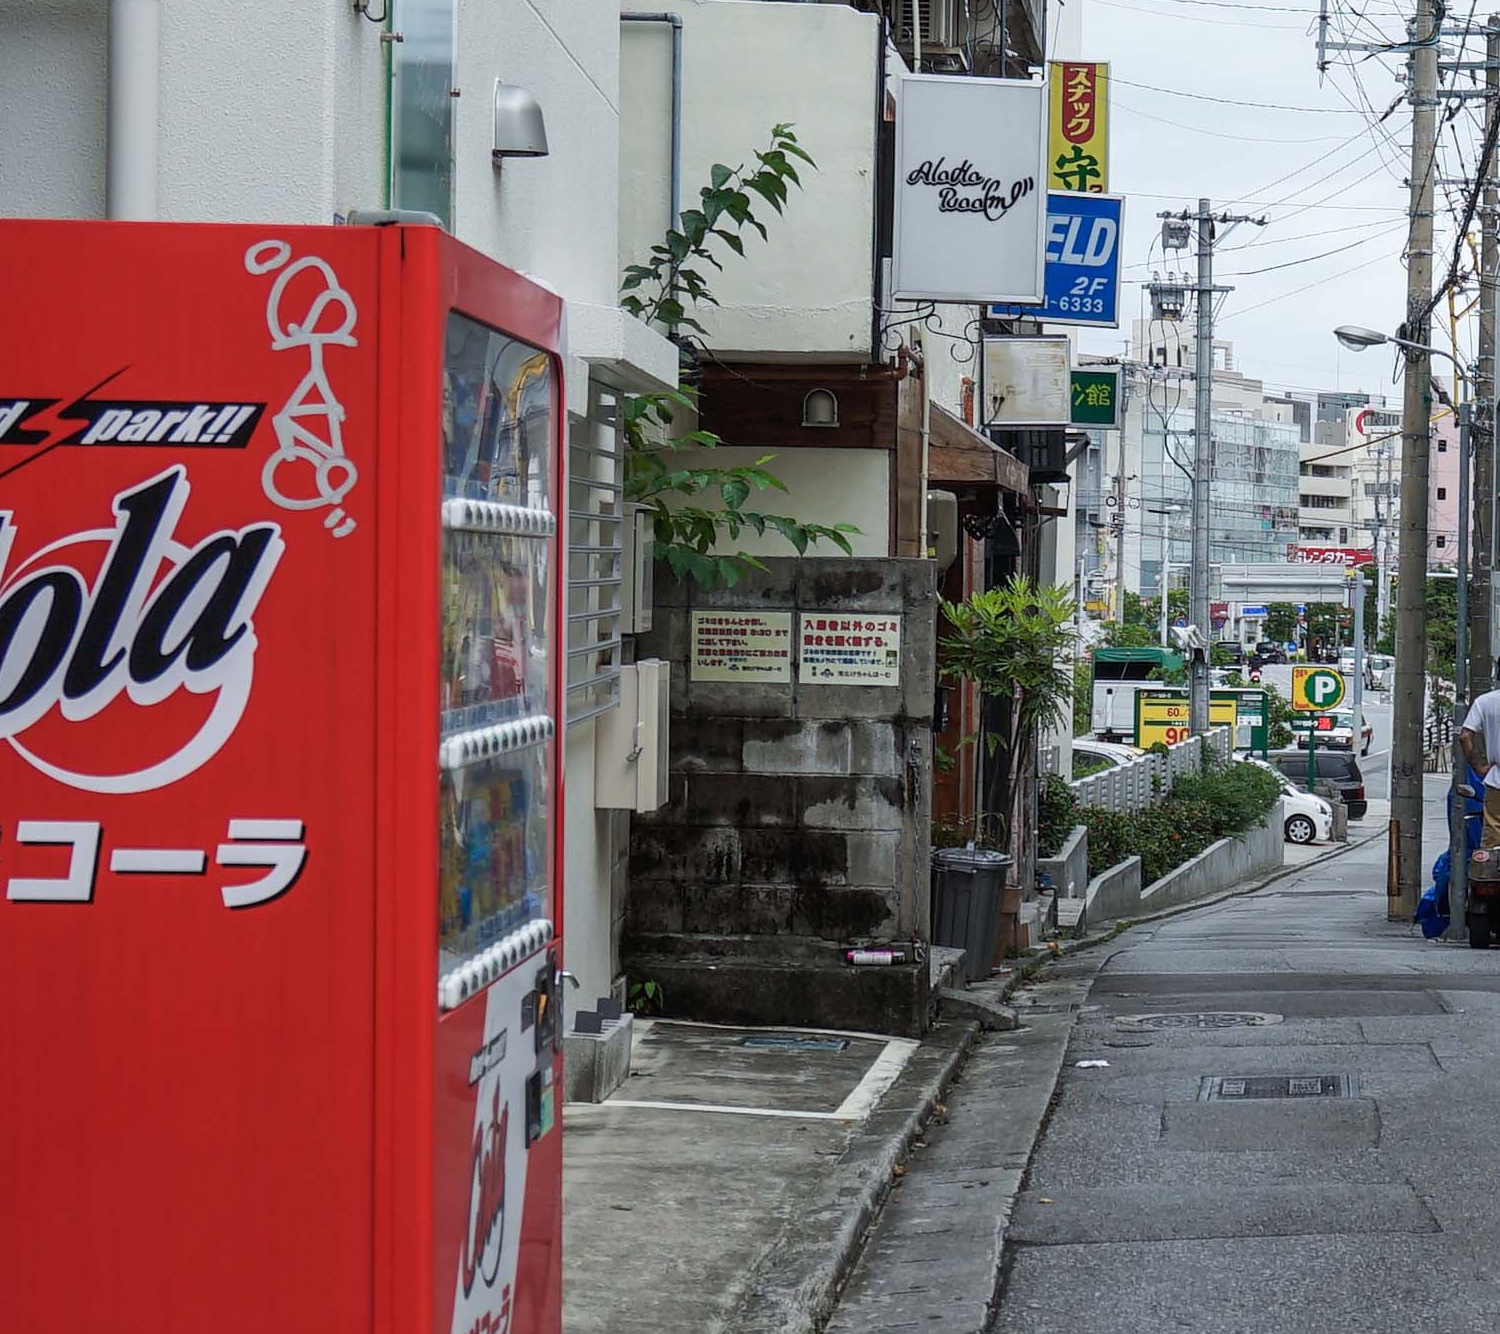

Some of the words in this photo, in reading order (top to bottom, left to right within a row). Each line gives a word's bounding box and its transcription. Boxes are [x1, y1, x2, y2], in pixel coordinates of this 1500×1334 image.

[1067, 67, 1092, 136] スナック
[1070, 276, 1108, 296] 2F
[1315, 676, 1336, 703] P
